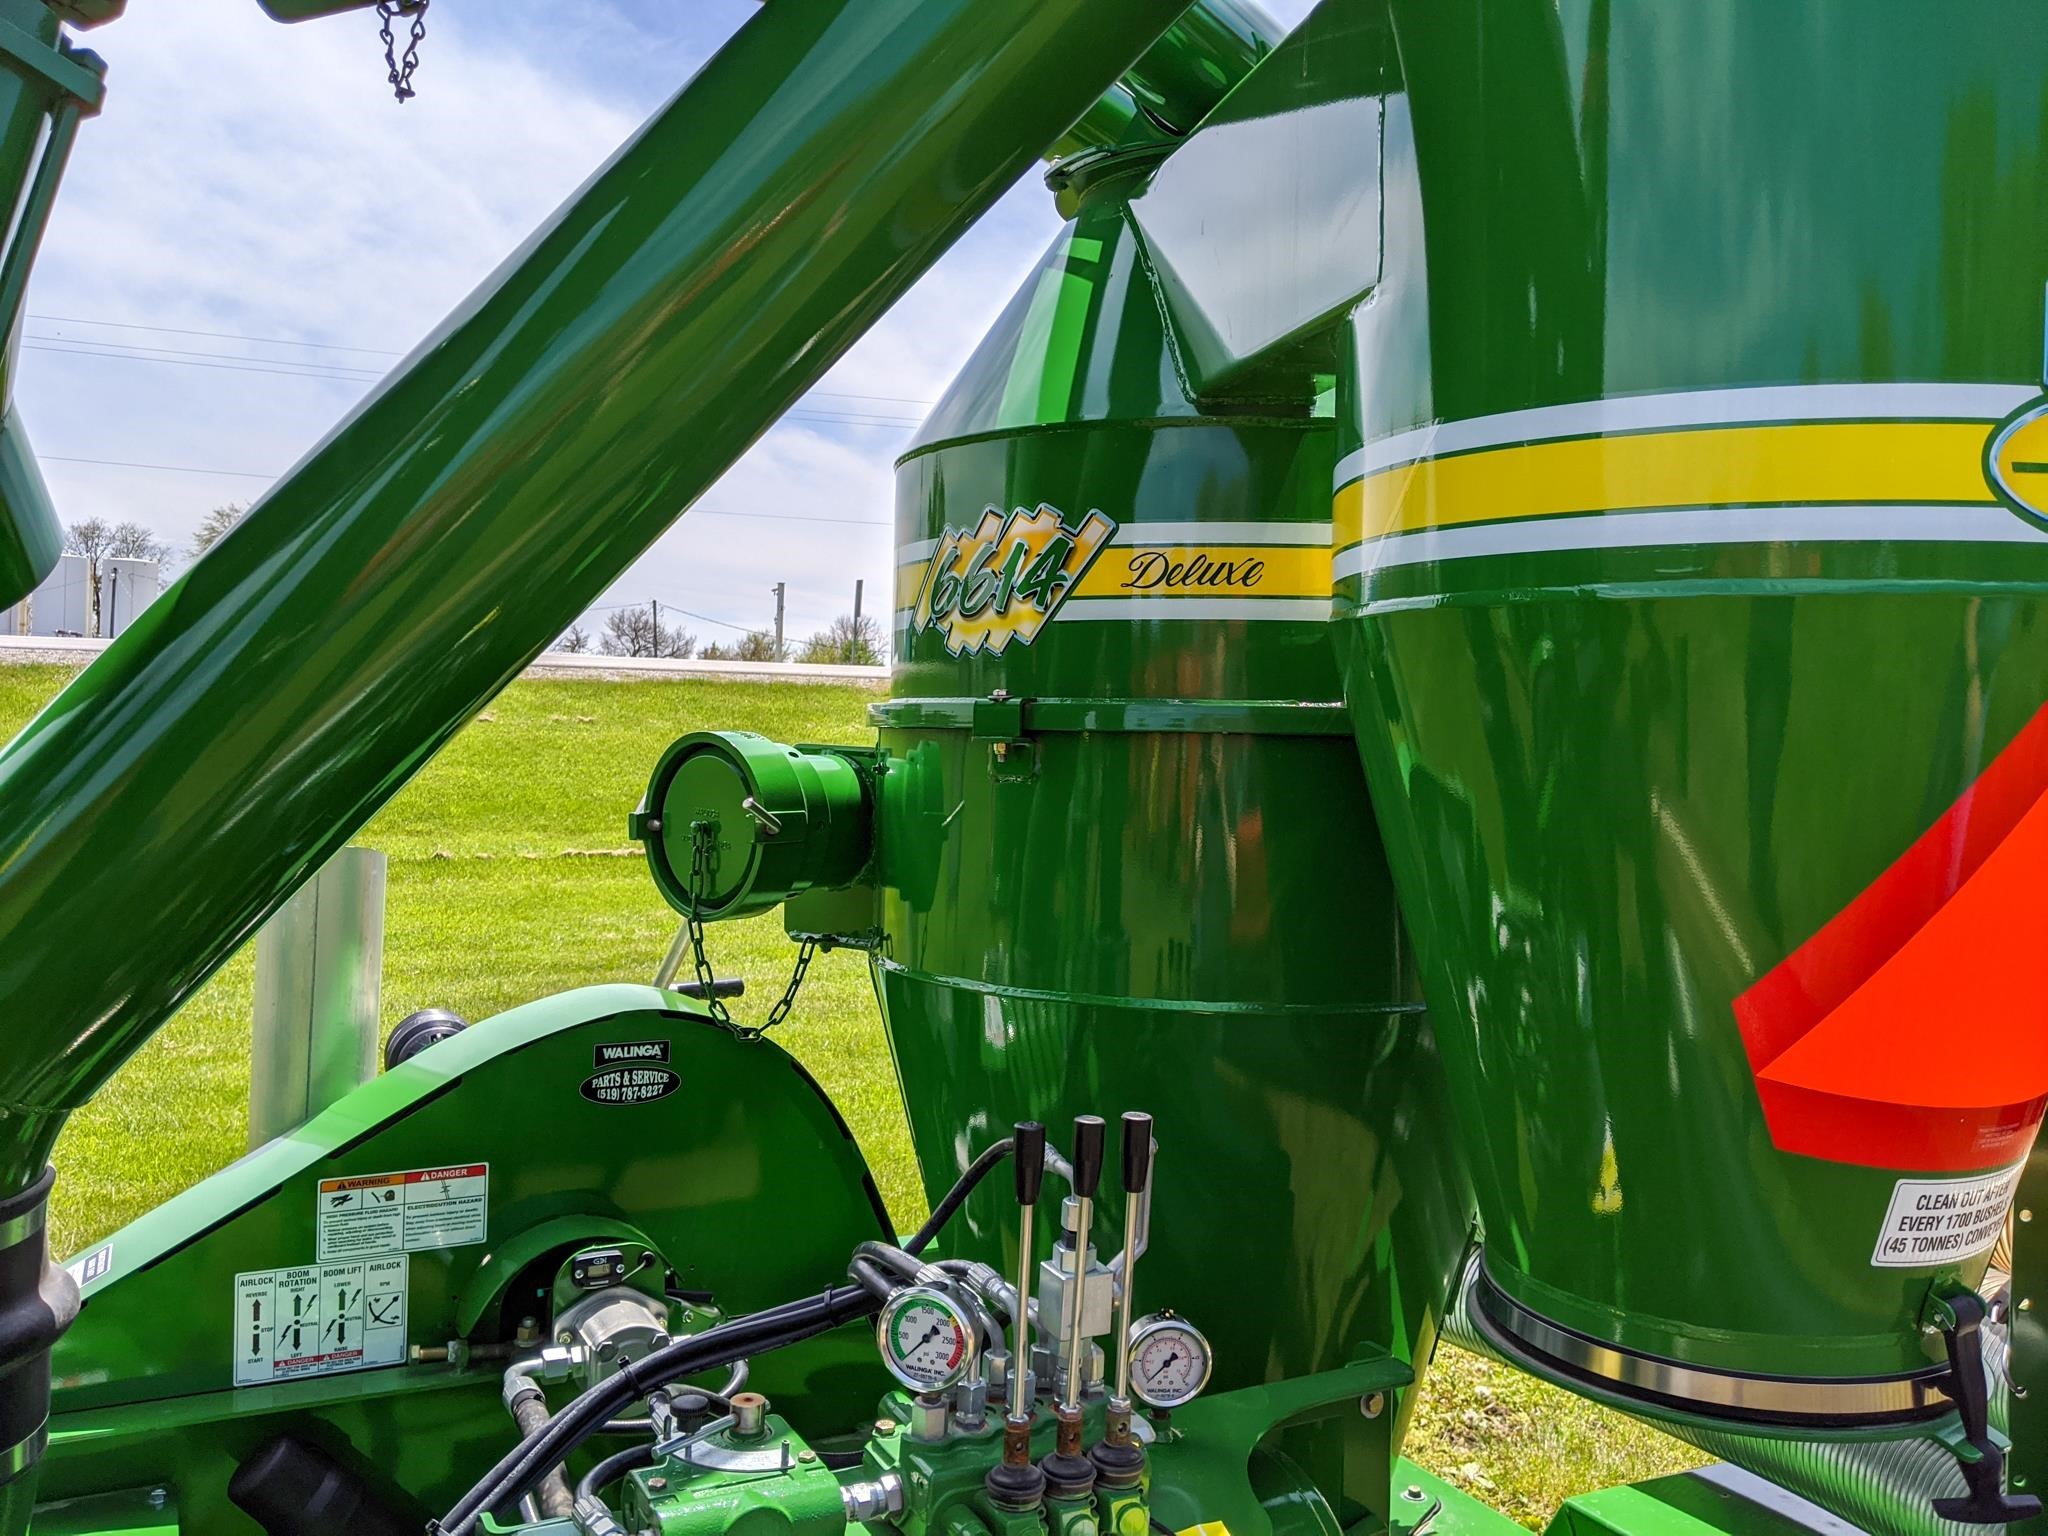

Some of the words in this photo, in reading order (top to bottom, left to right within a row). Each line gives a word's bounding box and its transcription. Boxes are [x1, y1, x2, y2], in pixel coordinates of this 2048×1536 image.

[1120, 551, 1265, 589] Deluxe
[929, 534, 1074, 619] 6614
[602, 1044, 662, 1060] WALINGA
[592, 1071, 621, 1088] PARTS
[622, 1071, 630, 1086] &
[631, 1070, 670, 1085] SERVICE
[597, 1087, 620, 1101] (519)
[621, 1084, 664, 1101] 787-8227
[430, 1168, 468, 1179] DANGER
[347, 1177, 390, 1188] WARNING
[1915, 1191, 1959, 1211] CLEAN
[1960, 1188, 1985, 1208] OUT
[1898, 1216, 1943, 1232] EVERY
[1945, 1210, 1972, 1231] 1700
[1882, 1236, 1908, 1256] (45
[1911, 1232, 1964, 1254] TONNES)
[324, 1268, 346, 1278] BOOM
[346, 1265, 362, 1275] LIFT
[369, 1261, 401, 1272] AIRLOCK
[287, 1269, 310, 1279] BOOM
[240, 1277, 274, 1287] AIRLOCK
[278, 1277, 317, 1288] ROTATION
[921, 1306, 934, 1315] 1500
[904, 1315, 918, 1324] 1000
[936, 1318, 950, 1327] 2000
[899, 1331, 909, 1340] 500
[942, 1336, 956, 1346] 2500
[331, 1351, 358, 1359] DANGER
[935, 1351, 950, 1361] 3000
[287, 1358, 315, 1366] DANGER
[905, 1363, 933, 1374] WALINGA
